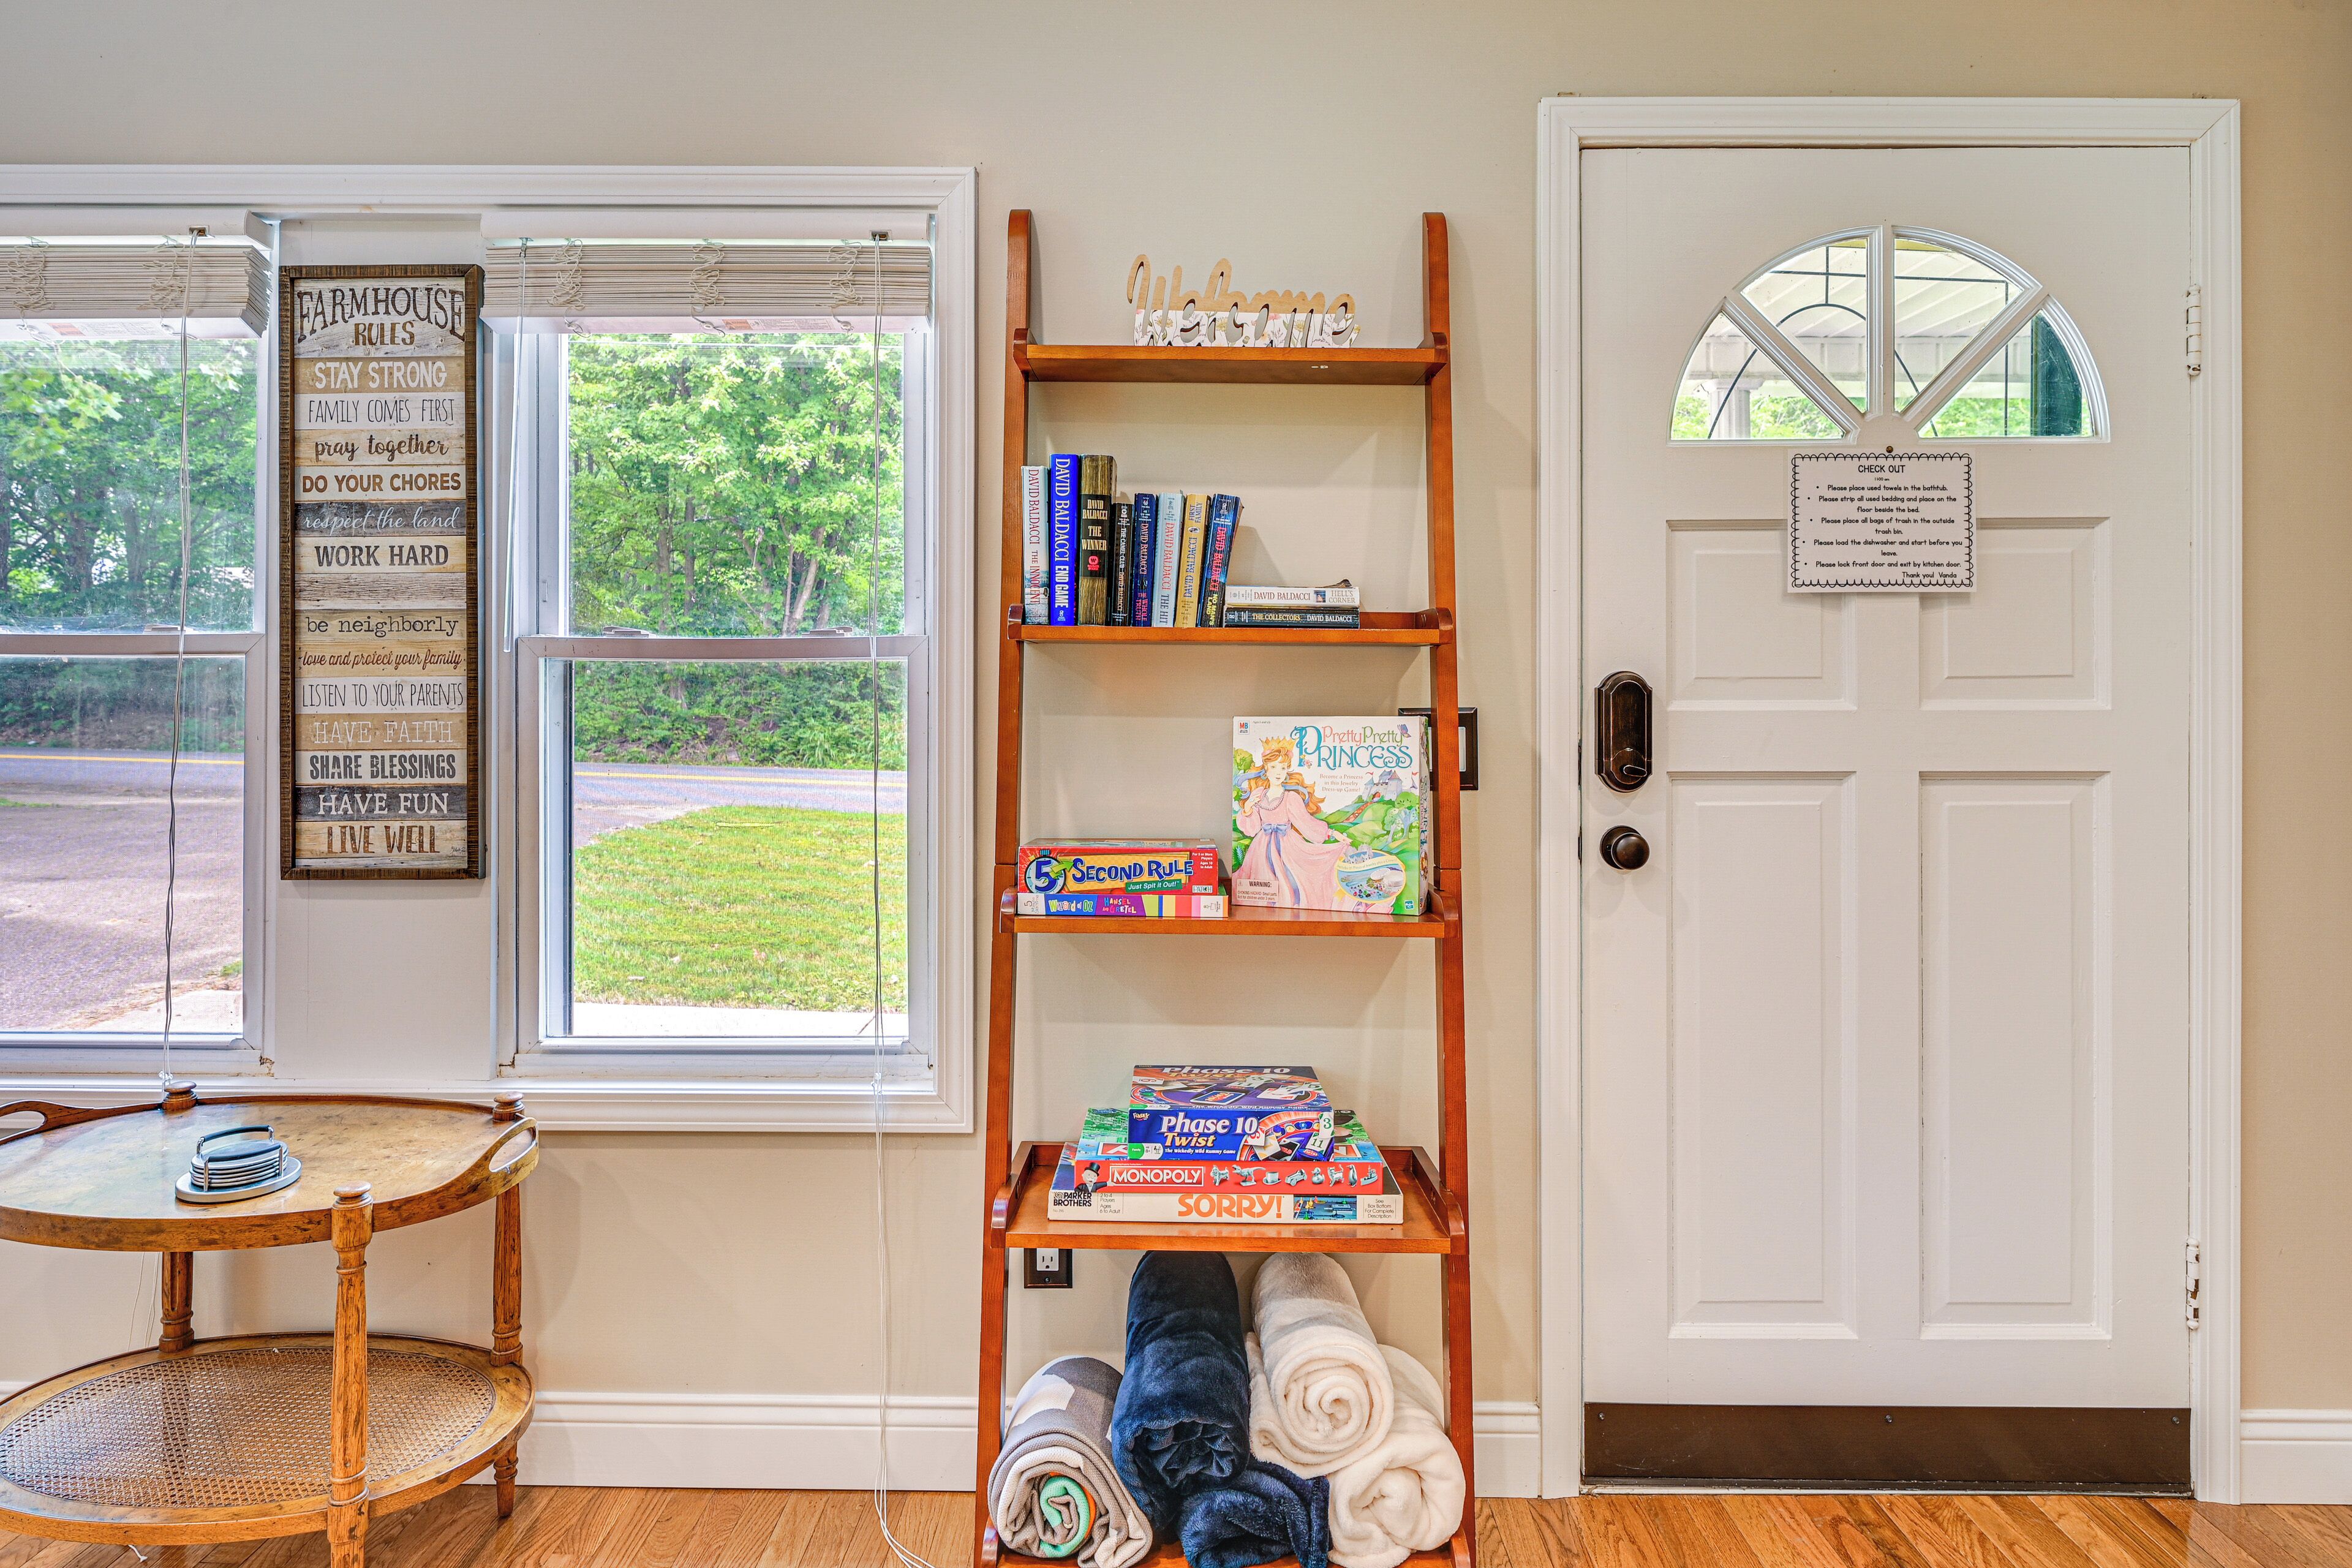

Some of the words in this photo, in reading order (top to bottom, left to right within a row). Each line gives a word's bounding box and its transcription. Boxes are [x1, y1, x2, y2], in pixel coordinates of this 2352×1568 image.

[1127, 254, 1360, 347] Welcome
[298, 287, 464, 344] FARMHOUSE
[355, 322, 415, 345] RULES
[315, 362, 363, 388] STAY
[369, 361, 447, 388] STRONG
[309, 401, 359, 423] FAMILY
[368, 399, 410, 422] COMES
[422, 399, 454, 421] FIRST
[315, 441, 359, 461] pray
[368, 434, 449, 462] together
[303, 475, 327, 492] DO
[334, 475, 383, 492] YOUR
[390, 473, 461, 491] CHORES
[1029, 469, 1039, 497] DAVID
[1055, 458, 1070, 496] DAVID
[1082, 510, 1107, 519] BALDACCI
[1087, 500, 1104, 510] DAVID
[304, 510, 375, 535] respect
[377, 507, 405, 531] the
[412, 507, 460, 529] land
[1029, 501, 1040, 545] BALDACCI
[1055, 500, 1070, 562] BALDACCI
[1088, 526, 1101, 537] THE
[1082, 540, 1107, 551] WINNER
[1166, 522, 1175, 548] DAVID
[315, 546, 380, 567] WORK
[389, 545, 448, 565] HARD
[1186, 537, 1197, 573] BALDACCI
[1055, 565, 1068, 582] END
[1162, 549, 1174, 590] BALDACCI
[1030, 565, 1040, 605] INNOCENT
[1055, 584, 1068, 608] GAME
[1183, 575, 1194, 598] DAVID
[1161, 594, 1169, 609] THE
[1212, 594, 1218, 603] NO
[306, 617, 328, 632] be
[339, 616, 458, 637] neighborly
[1159, 610, 1169, 625] HIT
[303, 652, 326, 666] love
[329, 651, 351, 665] and
[352, 651, 392, 669] protect
[395, 655, 422, 669] your
[423, 649, 462, 670] family
[303, 684, 345, 707] LISTEN
[352, 684, 367, 706] TO
[373, 684, 404, 706] YOUR
[411, 683, 463, 706] PARENTS
[314, 722, 371, 744] HAVE
[383, 721, 453, 743] FAITH
[1322, 726, 1362, 746] Pretty
[1362, 726, 1403, 746] Pretty
[1290, 726, 1413, 770] PRINCESS
[310, 755, 362, 780] SHARE
[371, 754, 456, 778] BLESSINGS
[318, 793, 387, 815] HAVE
[399, 793, 448, 814] FUN
[327, 826, 375, 853] LIVE
[385, 826, 440, 853] WELL
[1035, 859, 1057, 892] 5
[1072, 858, 1145, 883] SECOND
[1147, 860, 1194, 881] RULE
[1049, 900, 1076, 912] Wizard
[1104, 897, 1131, 906] HANSEL
[1110, 905, 1136, 914] GRETEL
[1159, 1112, 1231, 1134] Phase
[1236, 1117, 1258, 1134] 10
[1164, 1133, 1215, 1147] Twist
[1114, 1169, 1200, 1183] MONOPOLY
[1178, 1194, 1282, 1218] SORRY!
